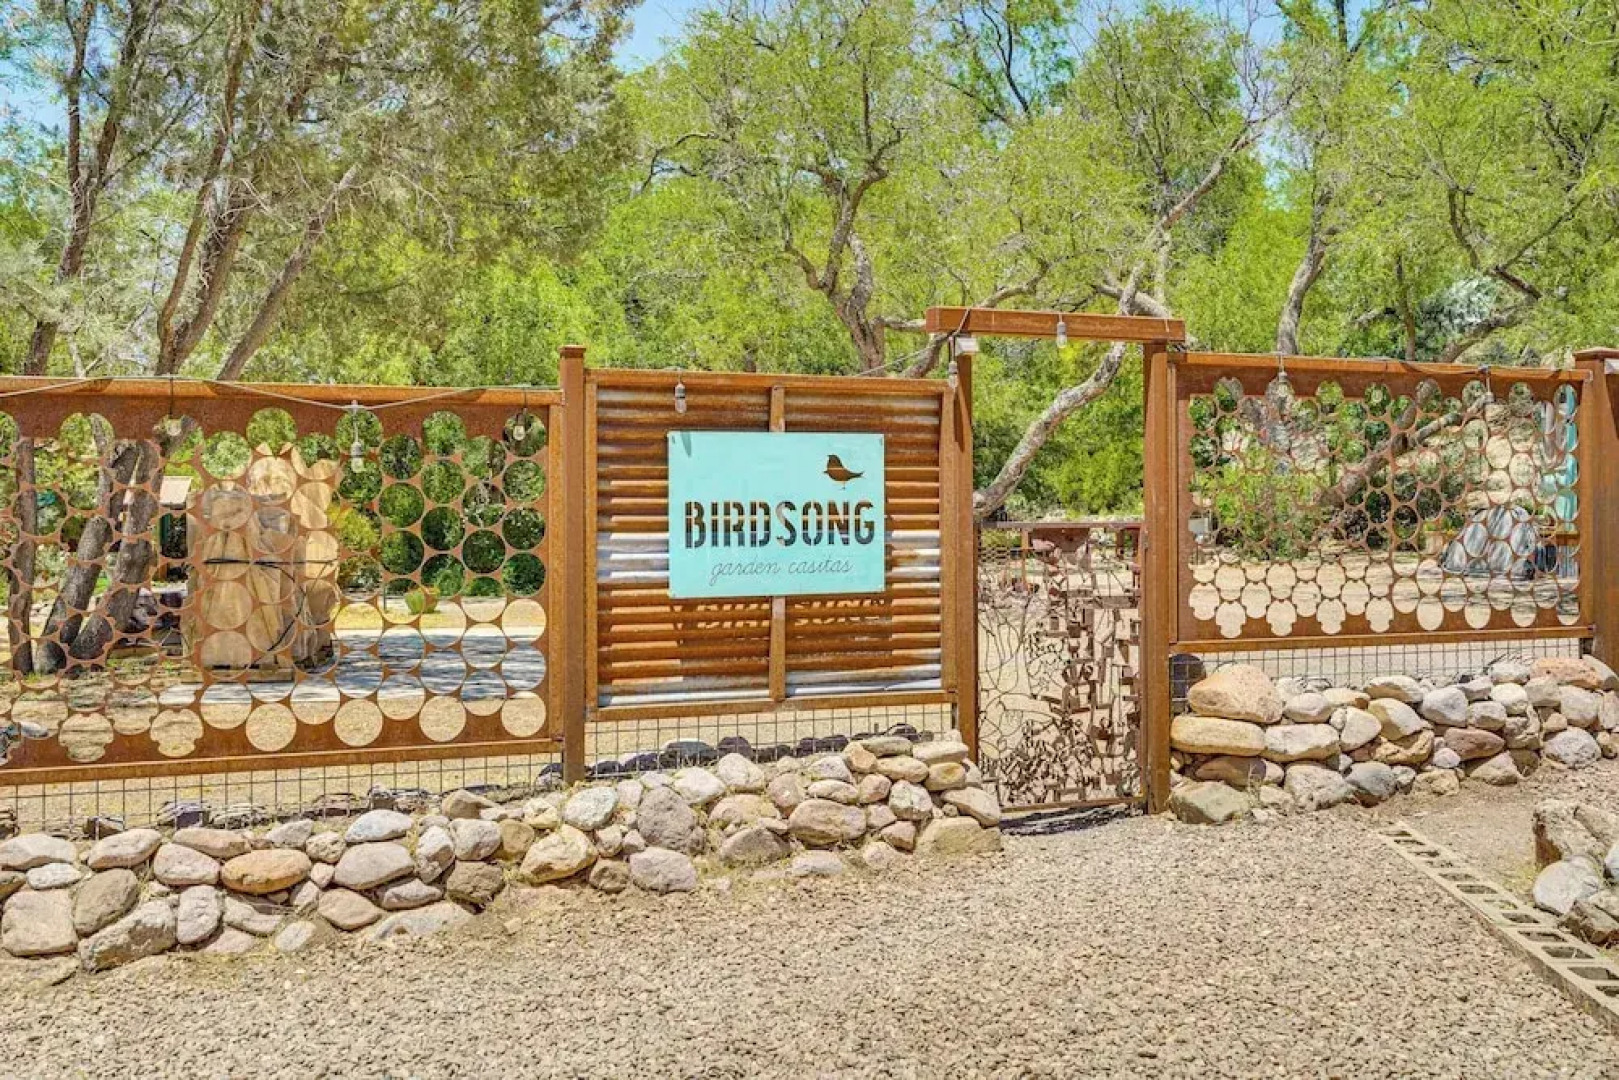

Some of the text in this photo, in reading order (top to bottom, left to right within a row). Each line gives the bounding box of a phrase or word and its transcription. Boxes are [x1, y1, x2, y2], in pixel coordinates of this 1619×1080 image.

[685, 501, 875, 548] BIRDSONG
[709, 556, 853, 586] garden casitas
